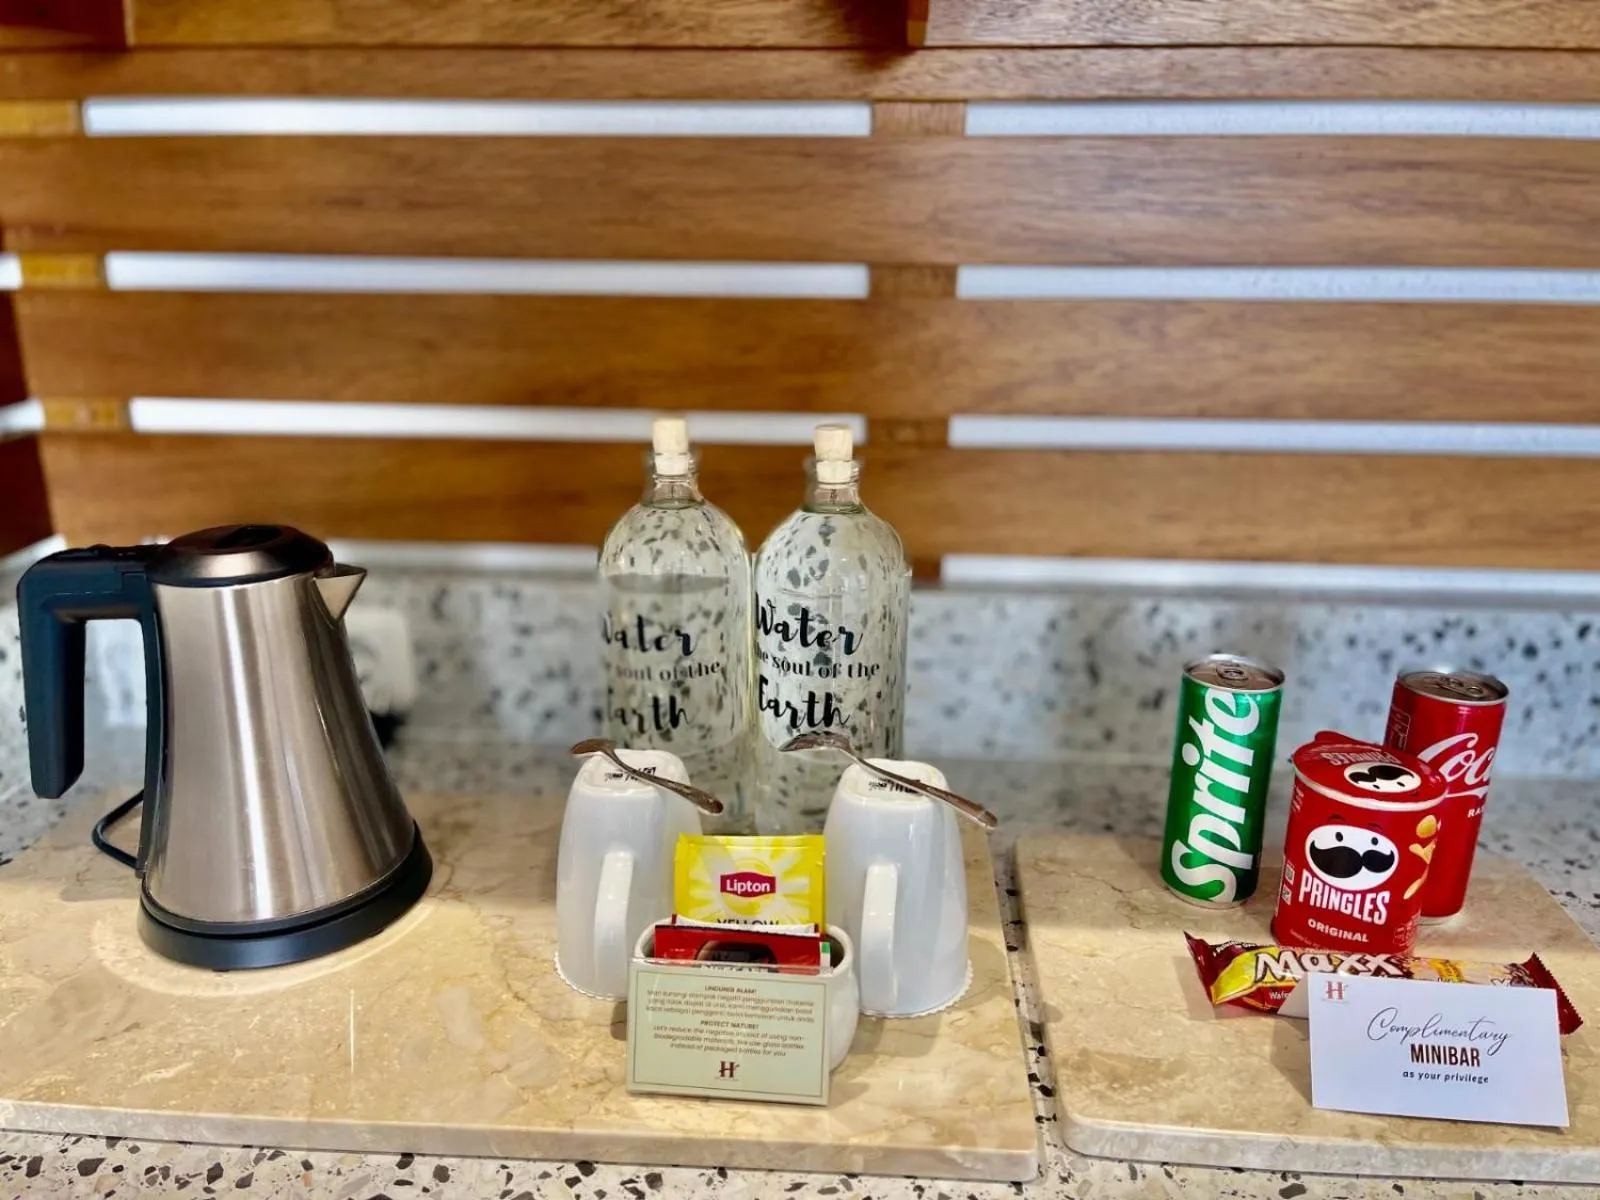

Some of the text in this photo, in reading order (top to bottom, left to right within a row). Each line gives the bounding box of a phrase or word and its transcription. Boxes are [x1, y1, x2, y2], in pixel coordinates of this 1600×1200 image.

[755, 591, 863, 655] Water
[687, 661, 720, 679] the
[772, 656, 810, 677] soul
[818, 662, 841, 679] of
[848, 662, 880, 680] the
[758, 674, 850, 729] Earth
[1320, 752, 1402, 766] PRINGLES
[1172, 687, 1260, 902] Sprite
[726, 880, 771, 895] Lipton
[1298, 868, 1390, 926] PRINGLES
[1307, 919, 1369, 943] ORIGINAL
[1255, 949, 1405, 982] Maxx
[1367, 1007, 1512, 1056] Complimentary
[1411, 1043, 1481, 1067] MINIBAR
[1403, 1071, 1489, 1084] as your privilege
